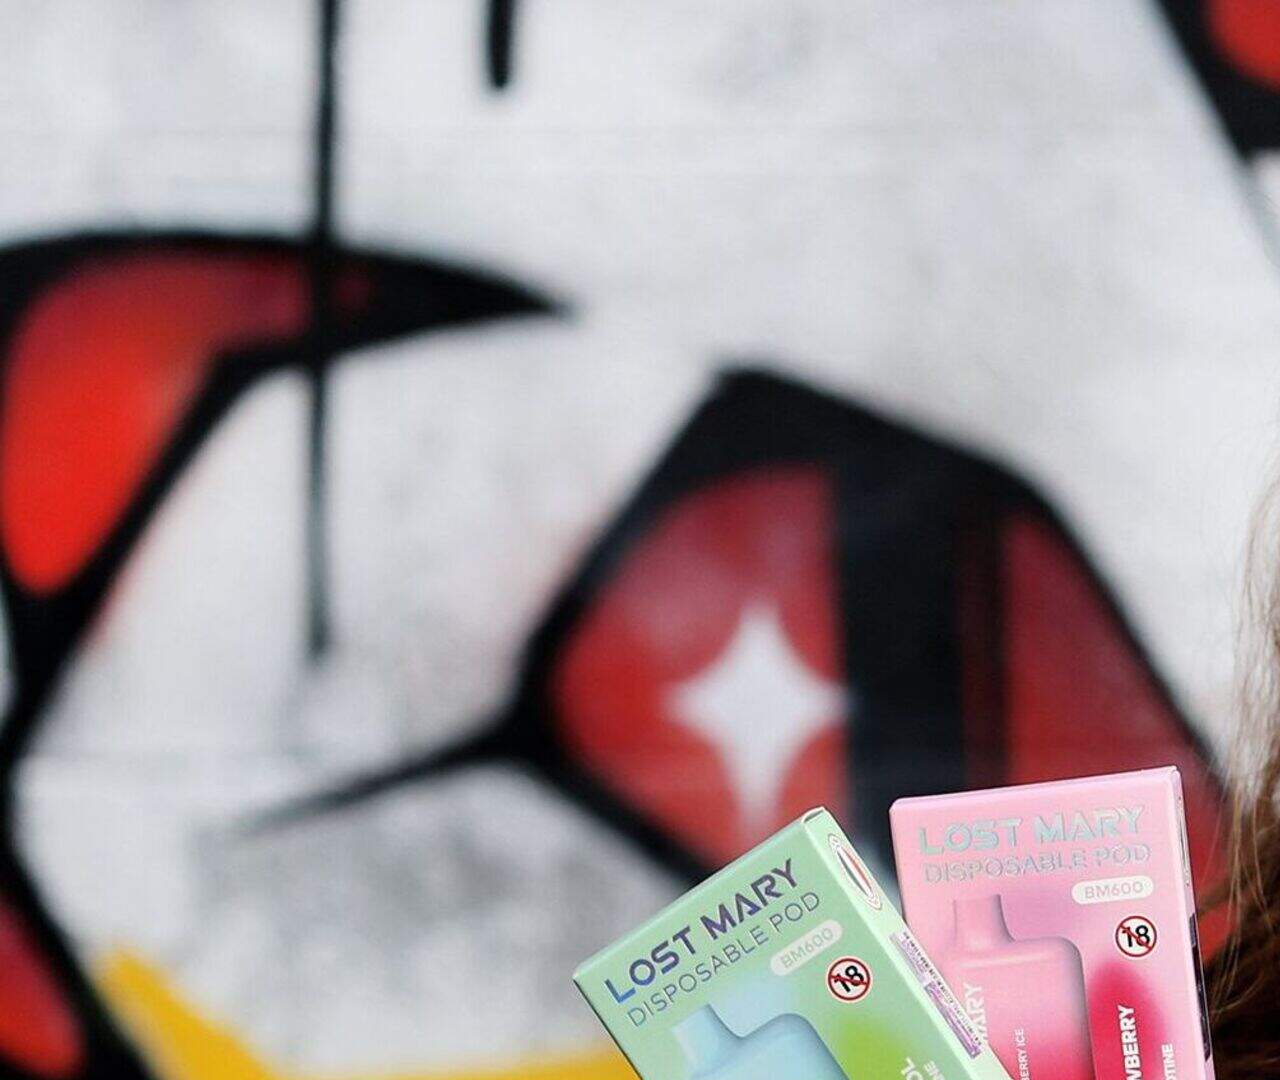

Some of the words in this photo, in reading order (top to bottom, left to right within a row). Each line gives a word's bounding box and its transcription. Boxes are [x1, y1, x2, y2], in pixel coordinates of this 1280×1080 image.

[917, 816, 1024, 856] LOST
[1033, 803, 1146, 844] MARY
[924, 851, 1087, 885] DISPOSABLE
[1094, 843, 1151, 868] POD
[1083, 881, 1144, 900] BM600
[604, 925, 702, 1005] LOST
[699, 857, 799, 941] MARY
[780, 928, 836, 971] BM600
[627, 924, 770, 1028] DISPOSABLE
[768, 890, 820, 933] POD
